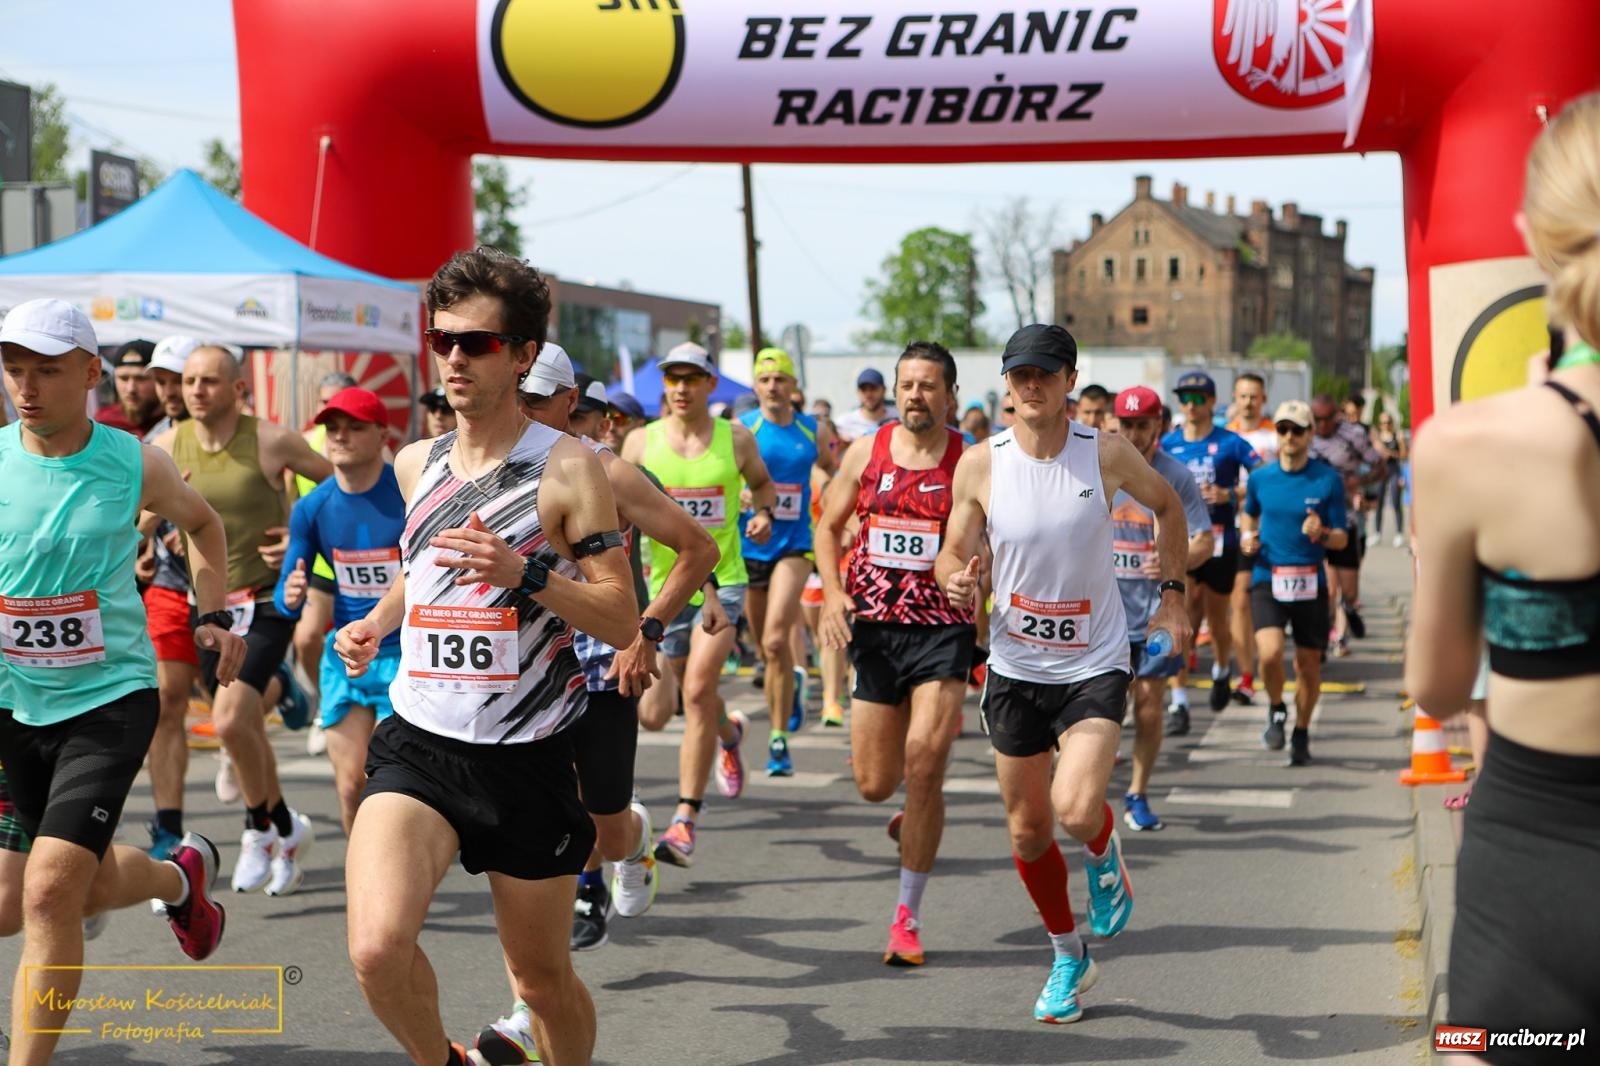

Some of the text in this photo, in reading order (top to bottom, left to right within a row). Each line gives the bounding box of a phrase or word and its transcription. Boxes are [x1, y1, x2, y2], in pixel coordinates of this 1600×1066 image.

[738, 8, 1139, 59] BEZ GRANIC
[773, 73, 1105, 125] RACIBÓRZ
[883, 533, 924, 555] 138
[1113, 553, 1140, 568] 216
[345, 566, 388, 585] 155
[1283, 577, 1306, 592] 173
[51, 595, 85, 605] GRANIC
[433, 609, 452, 617] BIEG
[452, 610, 467, 618] BEZ
[468, 611, 502, 619] GRANIC
[13, 617, 84, 648] 238
[1022, 615, 1075, 641] 236
[428, 634, 493, 670] 136
